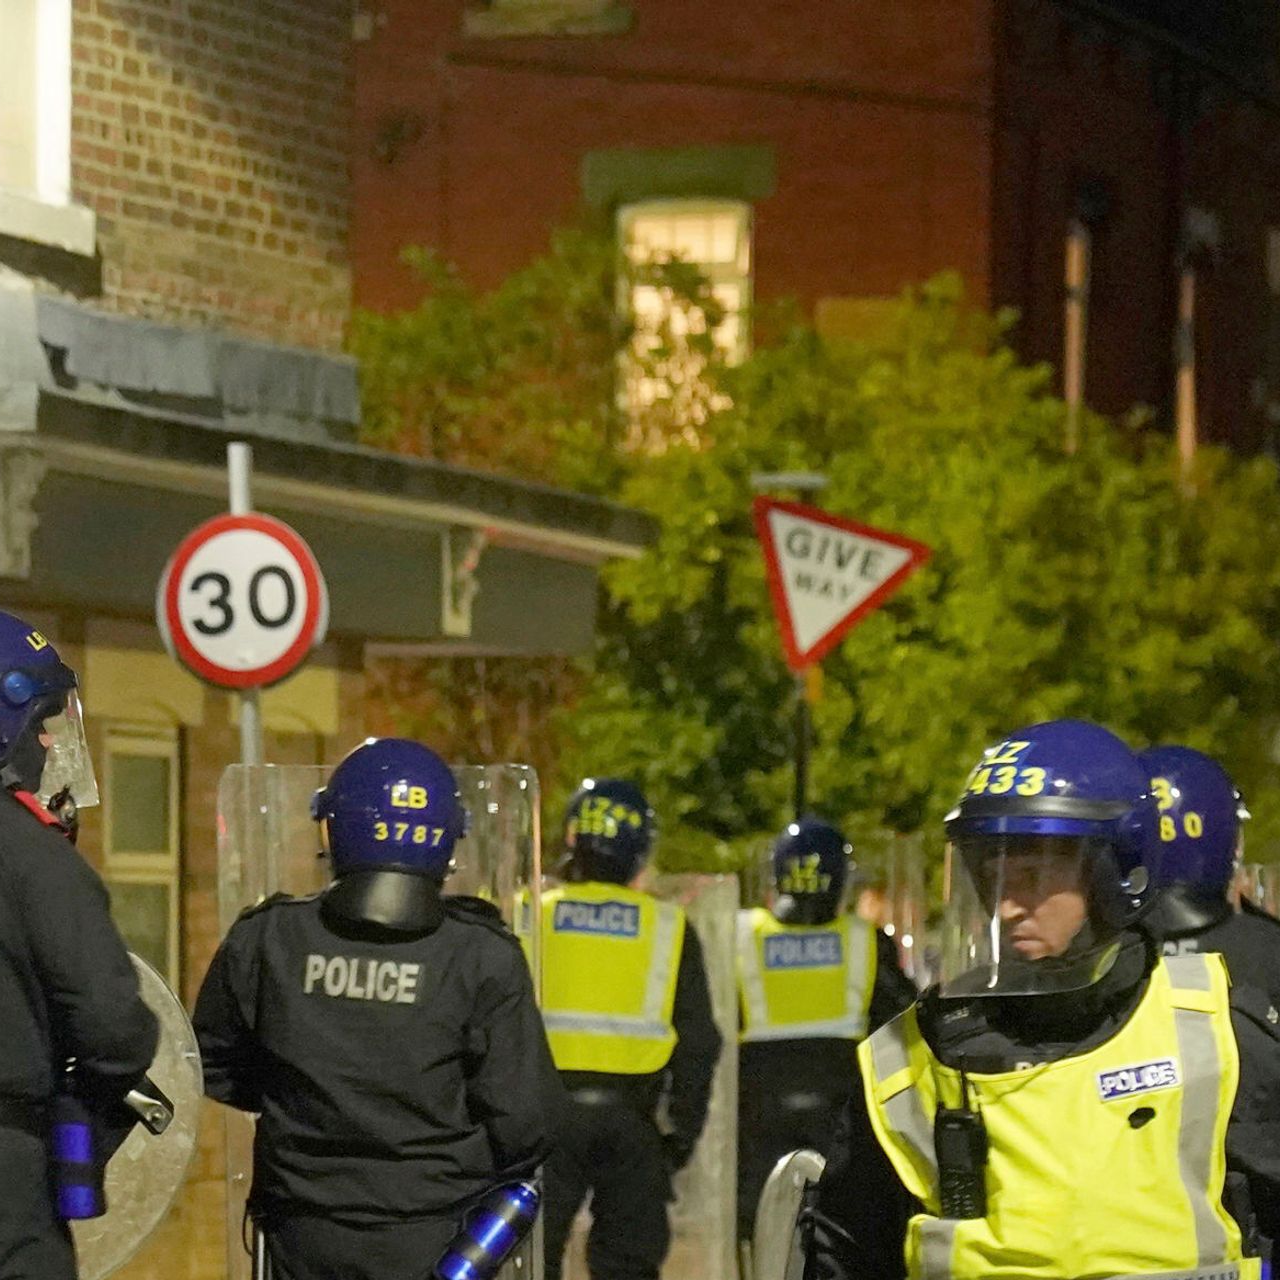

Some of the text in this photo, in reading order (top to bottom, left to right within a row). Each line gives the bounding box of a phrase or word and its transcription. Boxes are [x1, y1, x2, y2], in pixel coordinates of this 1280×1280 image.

[785, 526, 886, 582] GIVE
[190, 565, 296, 636] 30
[794, 571, 855, 604] WAY
[391, 785, 428, 809] LB
[374, 822, 445, 846] 3787
[556, 902, 635, 934] POLICE
[766, 937, 837, 966] POLICE
[303, 954, 421, 1004] POLICE
[1101, 1064, 1177, 1095] POLICE
